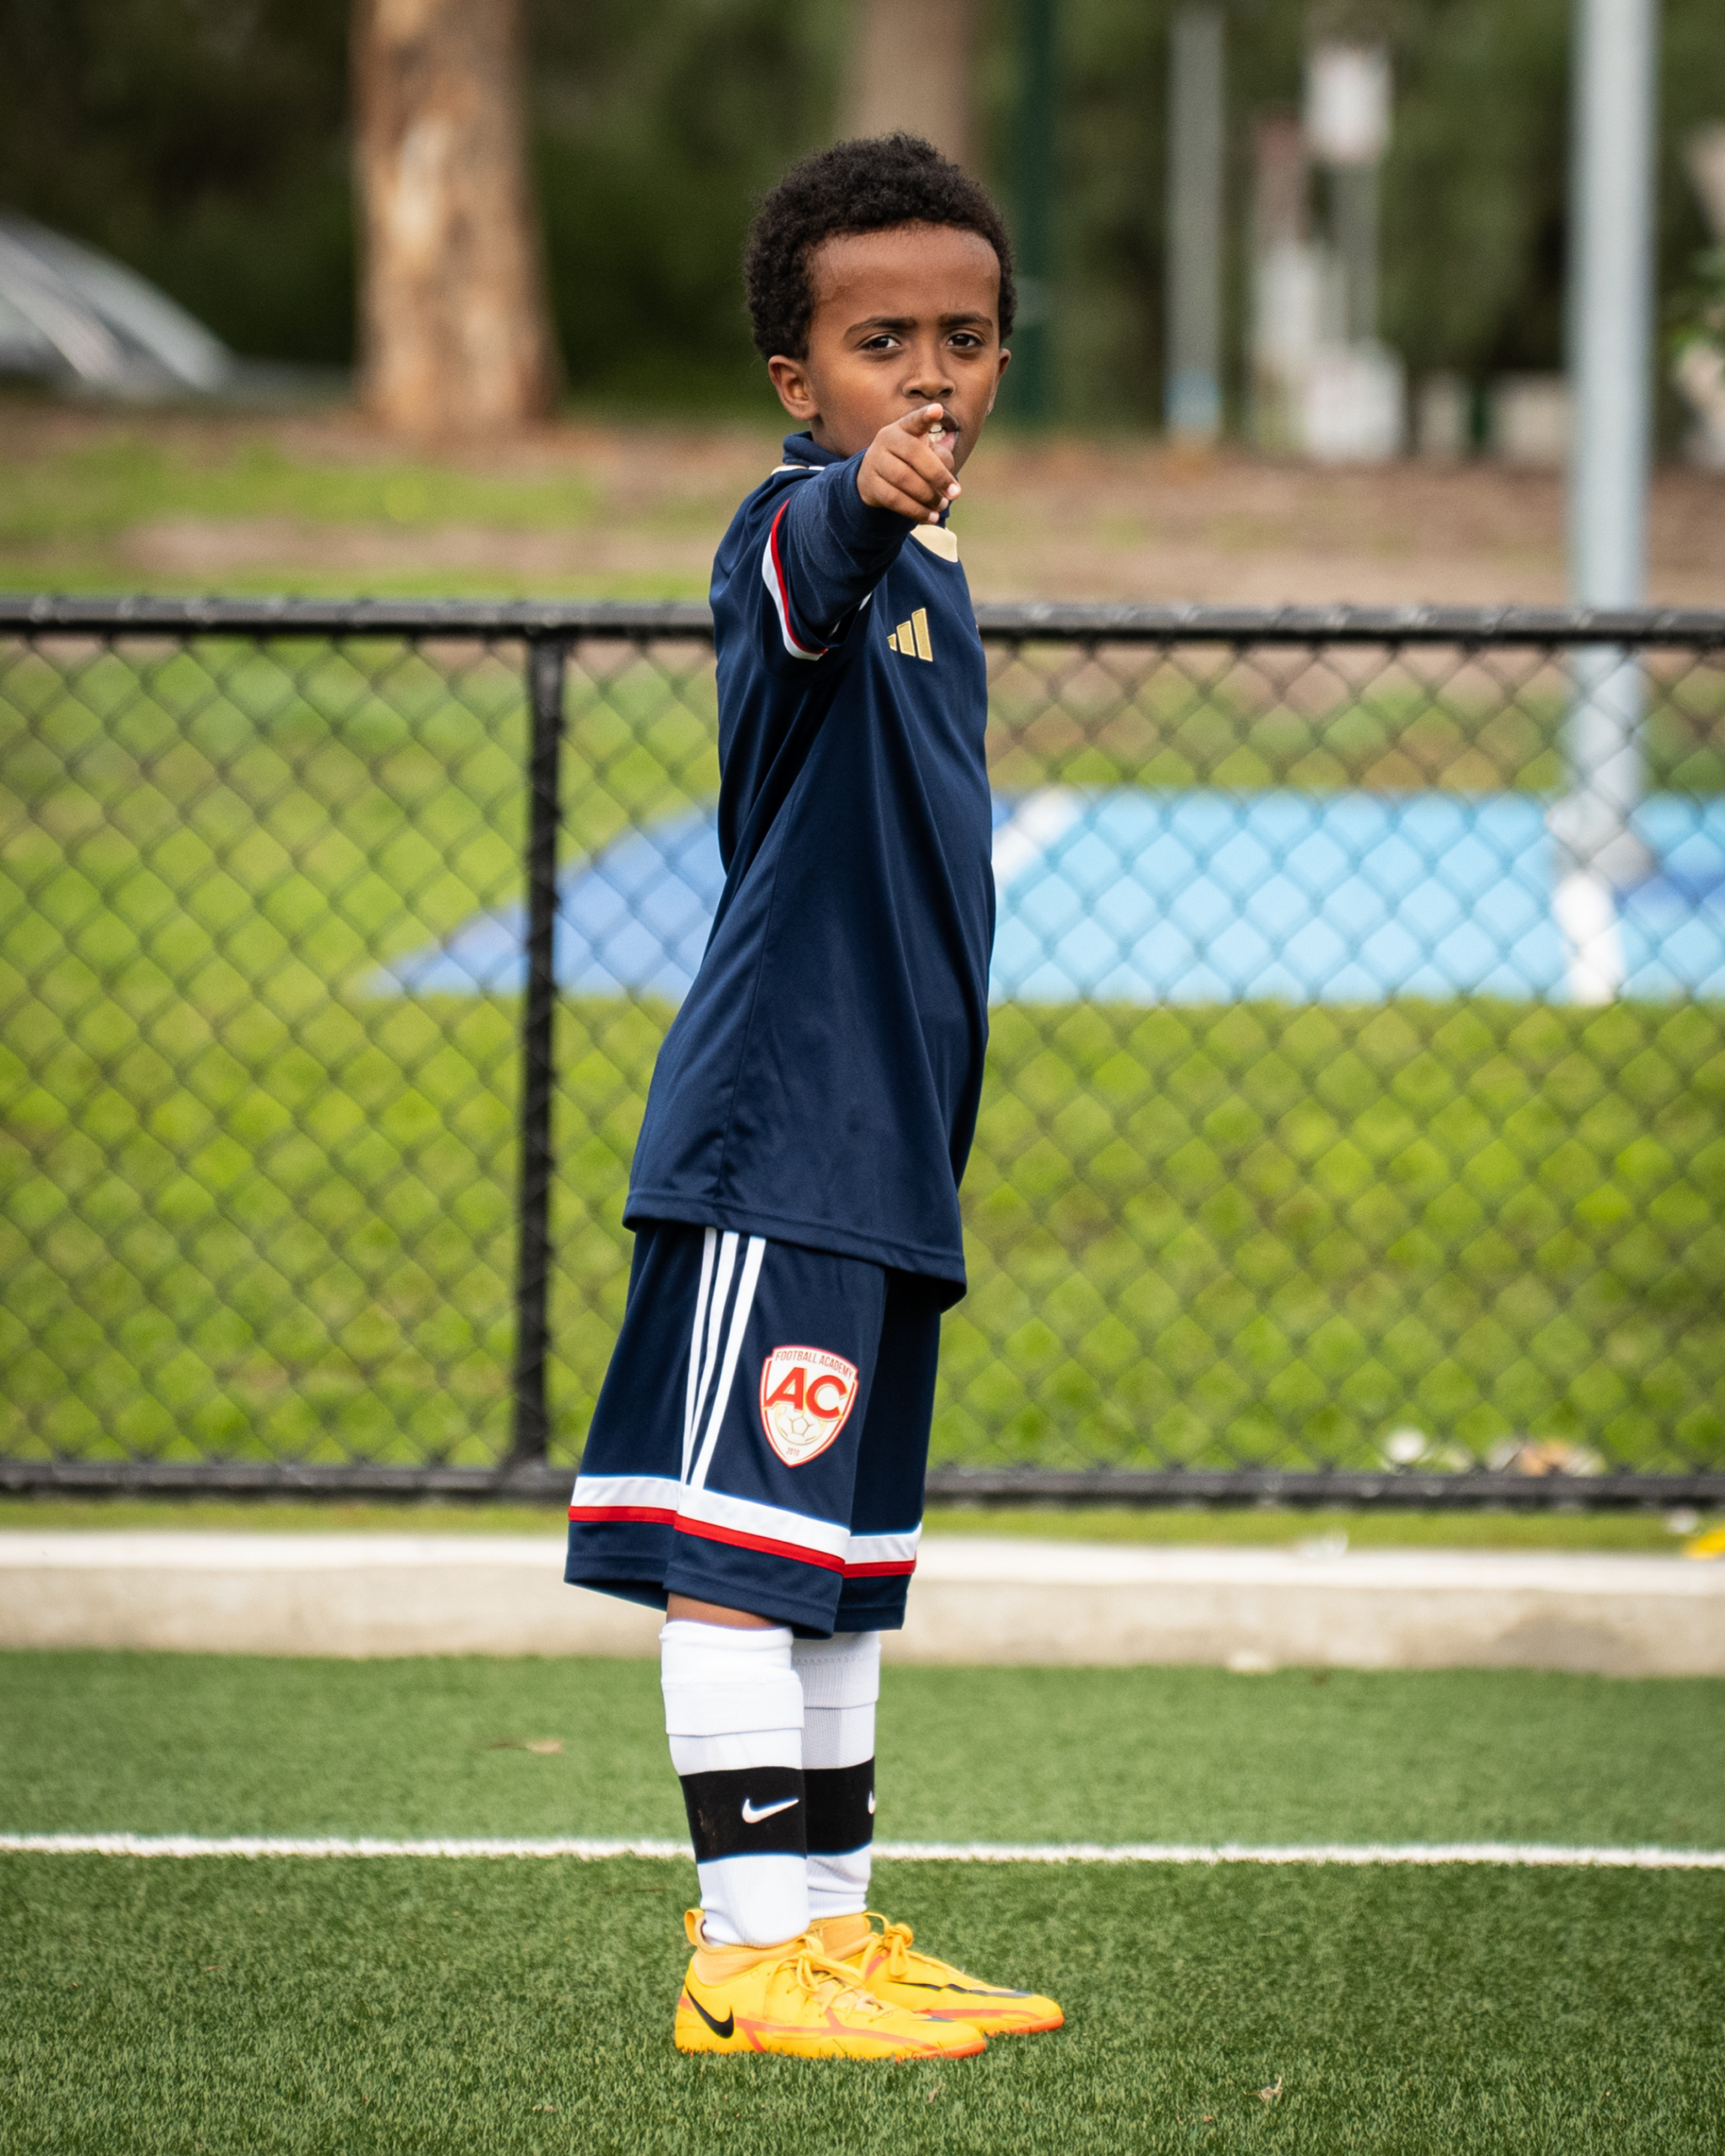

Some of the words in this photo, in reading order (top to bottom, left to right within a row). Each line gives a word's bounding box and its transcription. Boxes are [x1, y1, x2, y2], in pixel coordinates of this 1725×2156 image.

[775, 1350, 817, 1364] FOOTBALL
[819, 1355, 853, 1380] ACADEMY
[762, 1367, 848, 1421] AC
